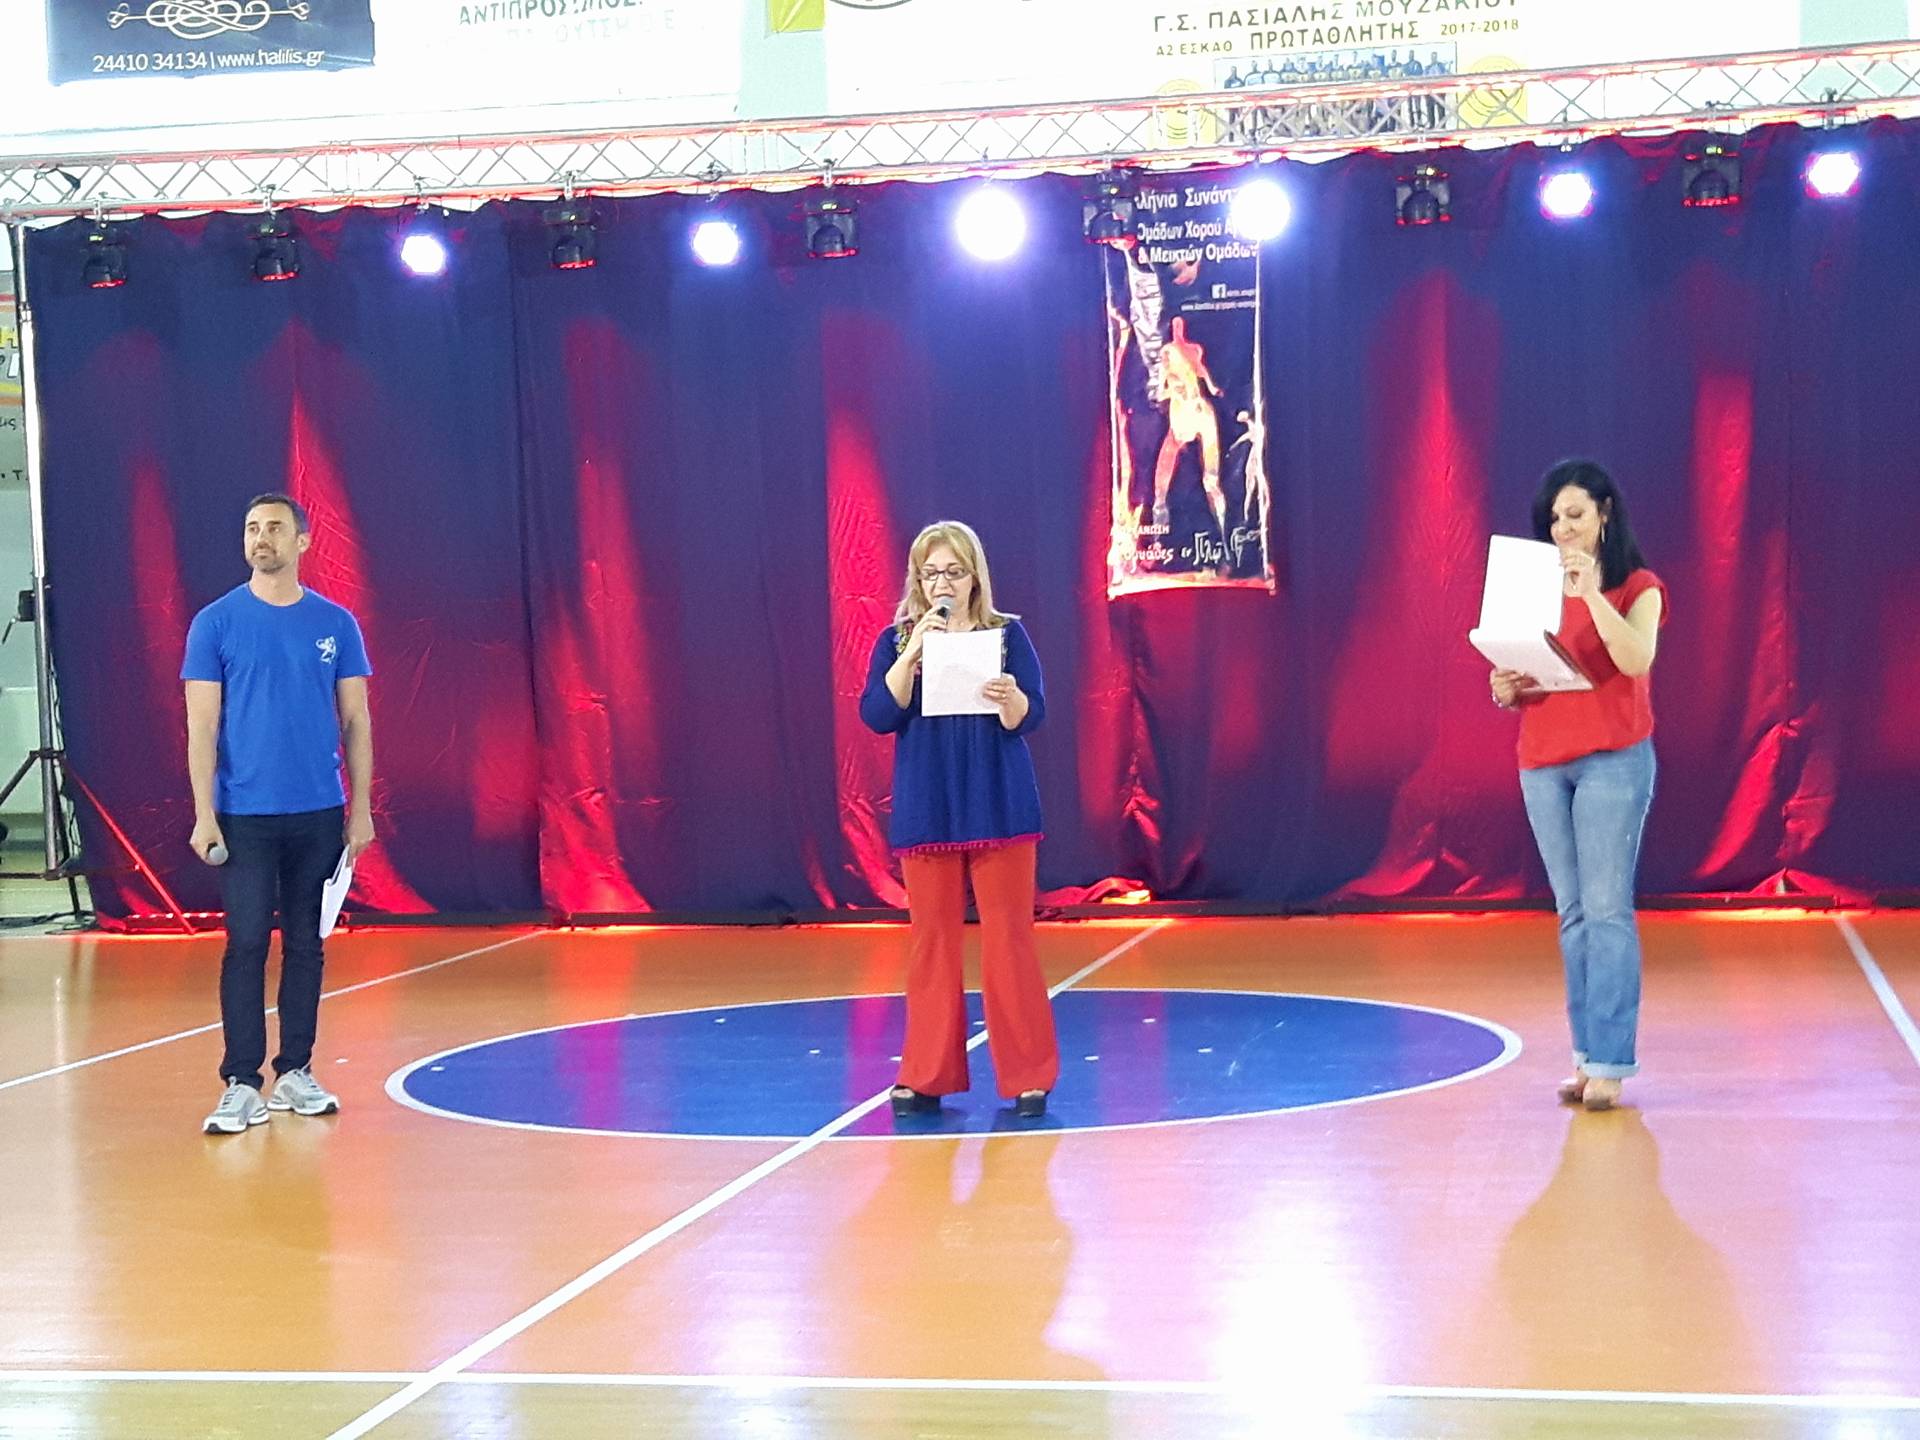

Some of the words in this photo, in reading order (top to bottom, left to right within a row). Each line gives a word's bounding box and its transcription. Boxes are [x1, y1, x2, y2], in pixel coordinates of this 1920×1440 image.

[1208, 3, 1344, 29] ΠΑΣΙΑΛΗΣ
[1250, 21, 1420, 50] ΠΡΩΤΑΘΛΗΤΗΣ
[1440, 19, 1519, 36] 2017-2018
[92, 53, 149, 73] 24410
[152, 51, 208, 71] 34134
[217, 48, 325, 68] www.halilis.gr
